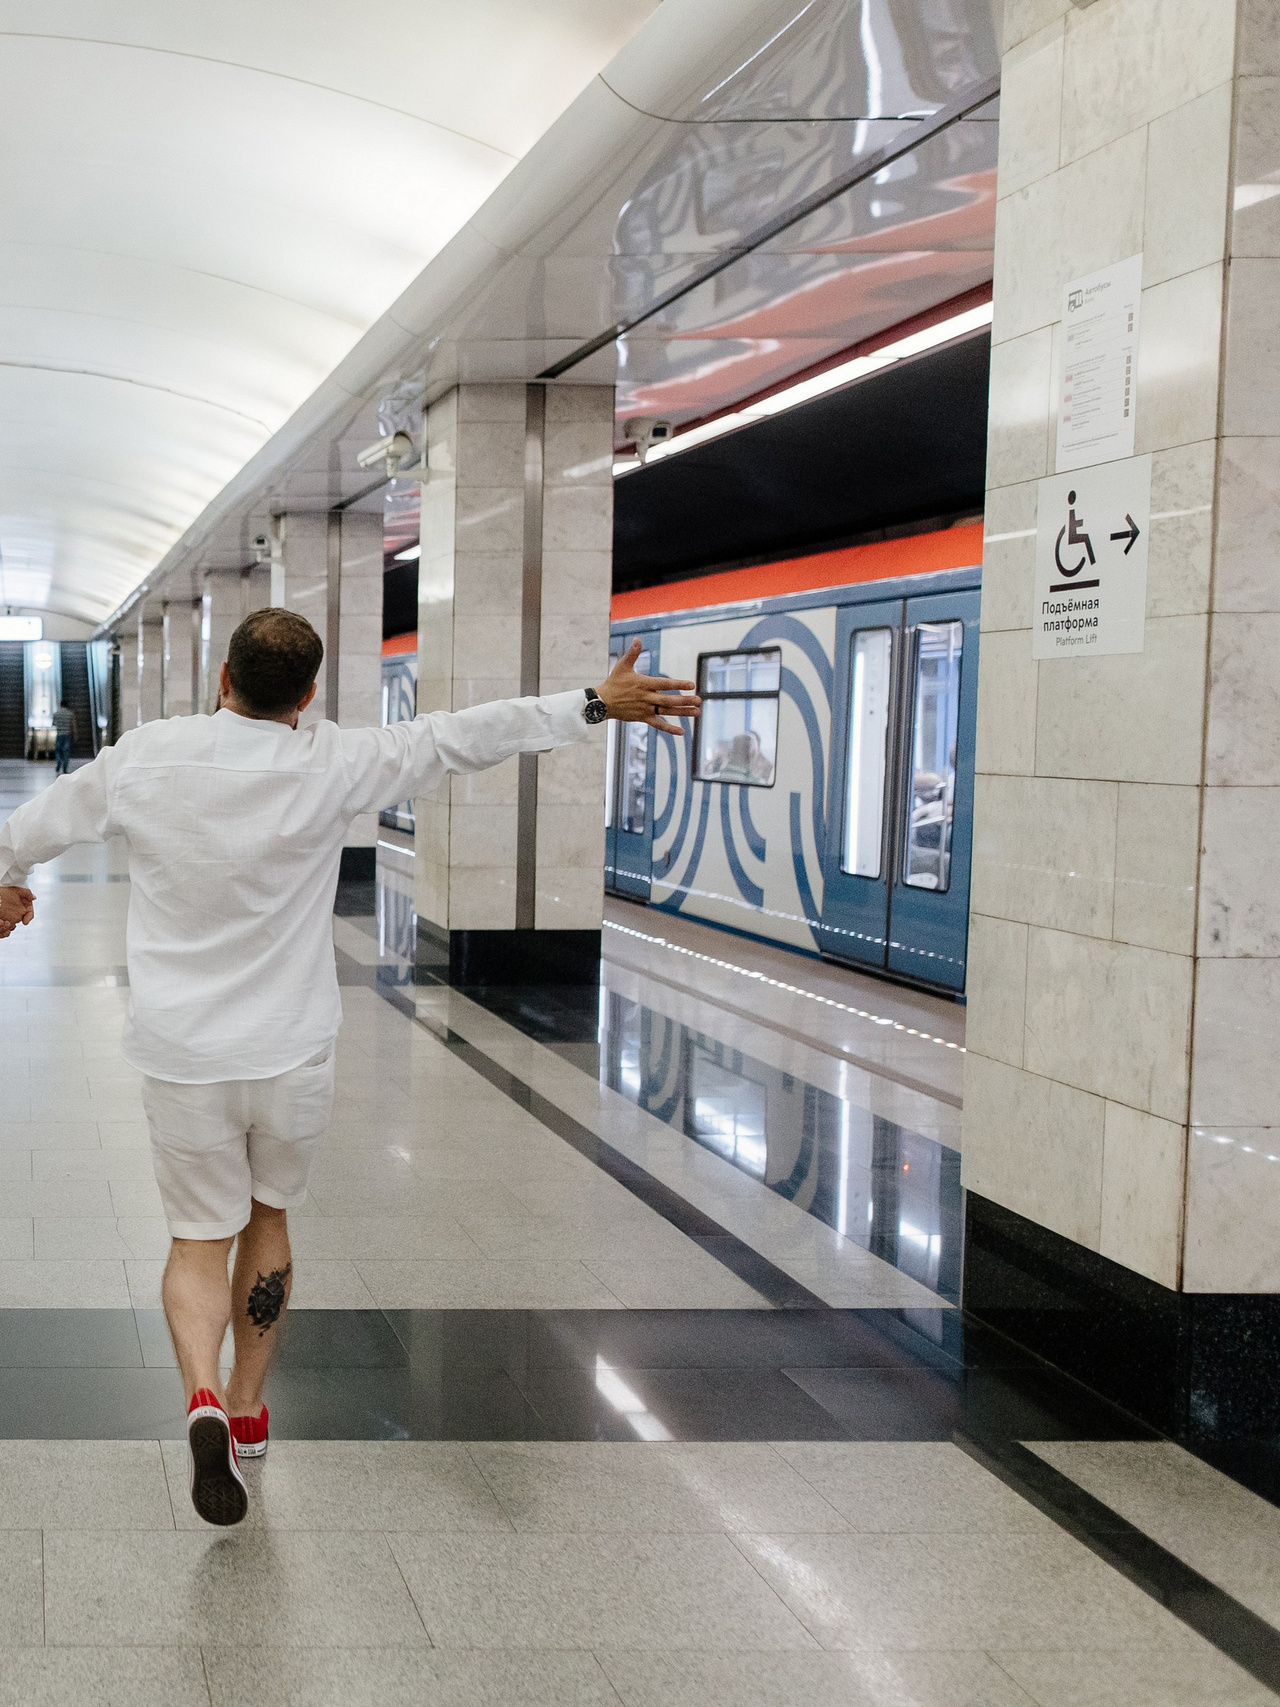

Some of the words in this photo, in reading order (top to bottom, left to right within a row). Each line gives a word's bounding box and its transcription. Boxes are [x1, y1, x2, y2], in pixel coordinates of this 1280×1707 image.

[1042, 599, 1099, 615] Подъёмная
[1043, 616, 1099, 632] платформа
[1055, 636, 1084, 646] Platform
[1085, 633, 1097, 644] Lift
